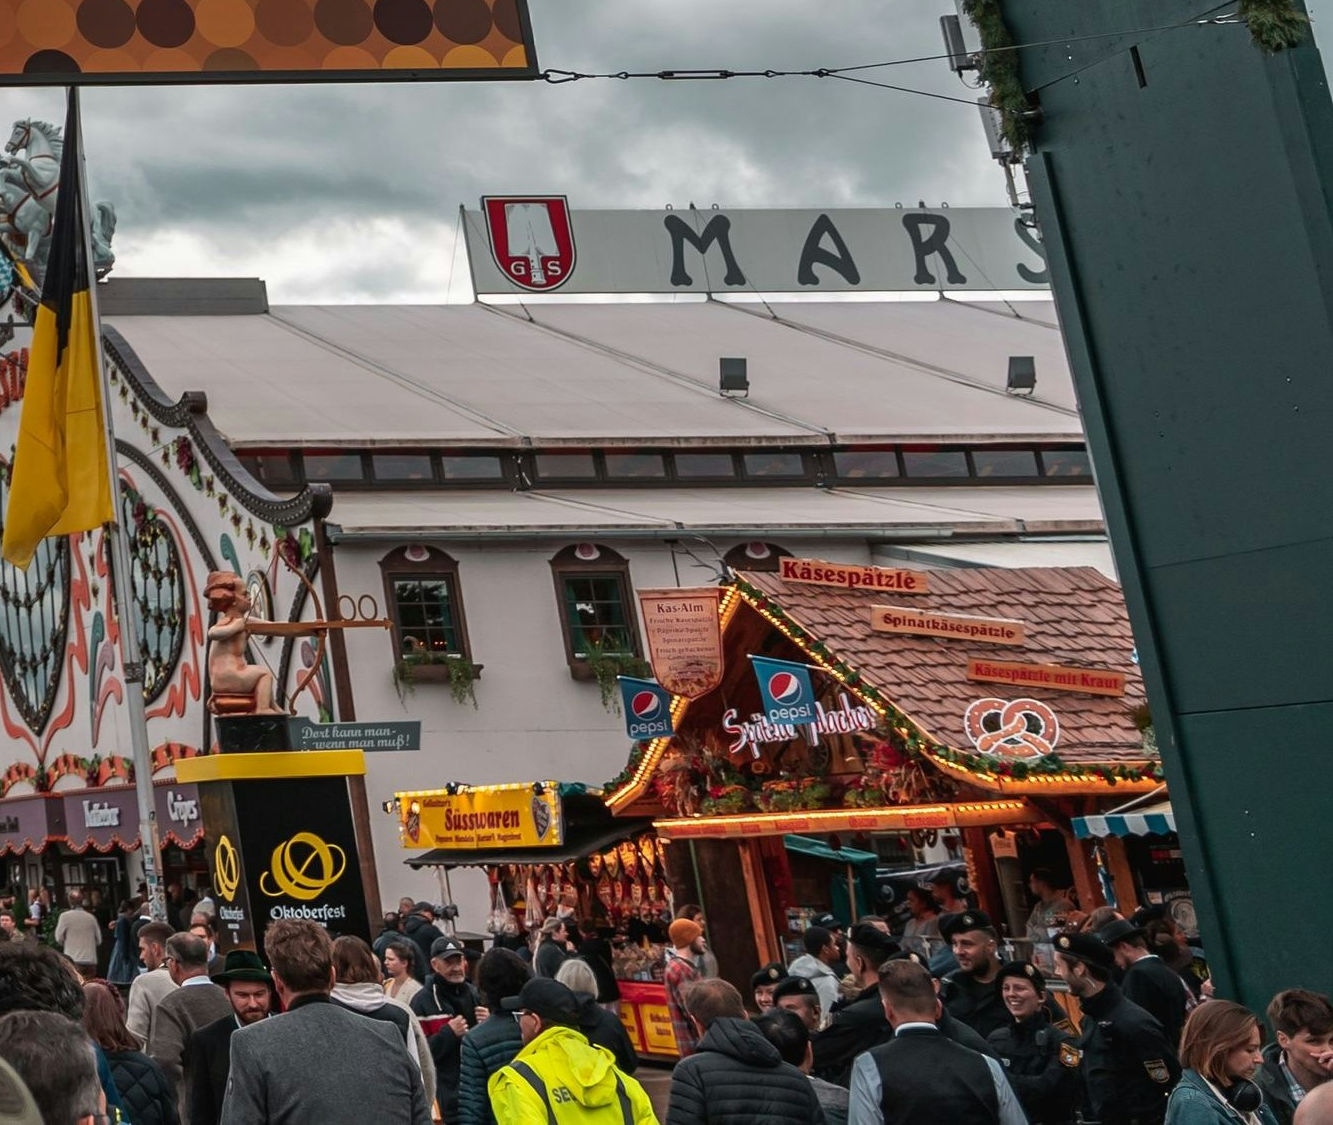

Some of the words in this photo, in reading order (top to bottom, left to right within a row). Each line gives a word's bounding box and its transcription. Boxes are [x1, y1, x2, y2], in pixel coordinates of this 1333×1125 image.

[782, 560, 917, 591] Käsespätzle
[882, 613, 1016, 640] Spinatkäsespätzle
[973, 662, 1054, 685] Käsespätzle
[1055, 669, 1077, 686] mit
[1081, 672, 1119, 690] Kraut
[769, 703, 811, 722] pepsi
[301, 726, 330, 740] Dort
[332, 725, 362, 738] kann
[630, 720, 668, 736] pepsi
[313, 739, 346, 750] wenn
[348, 739, 375, 749] man
[377, 734, 410, 750] muß!
[445, 808, 520, 831] Süsswaren
[270, 904, 346, 922] Oktoberfest
